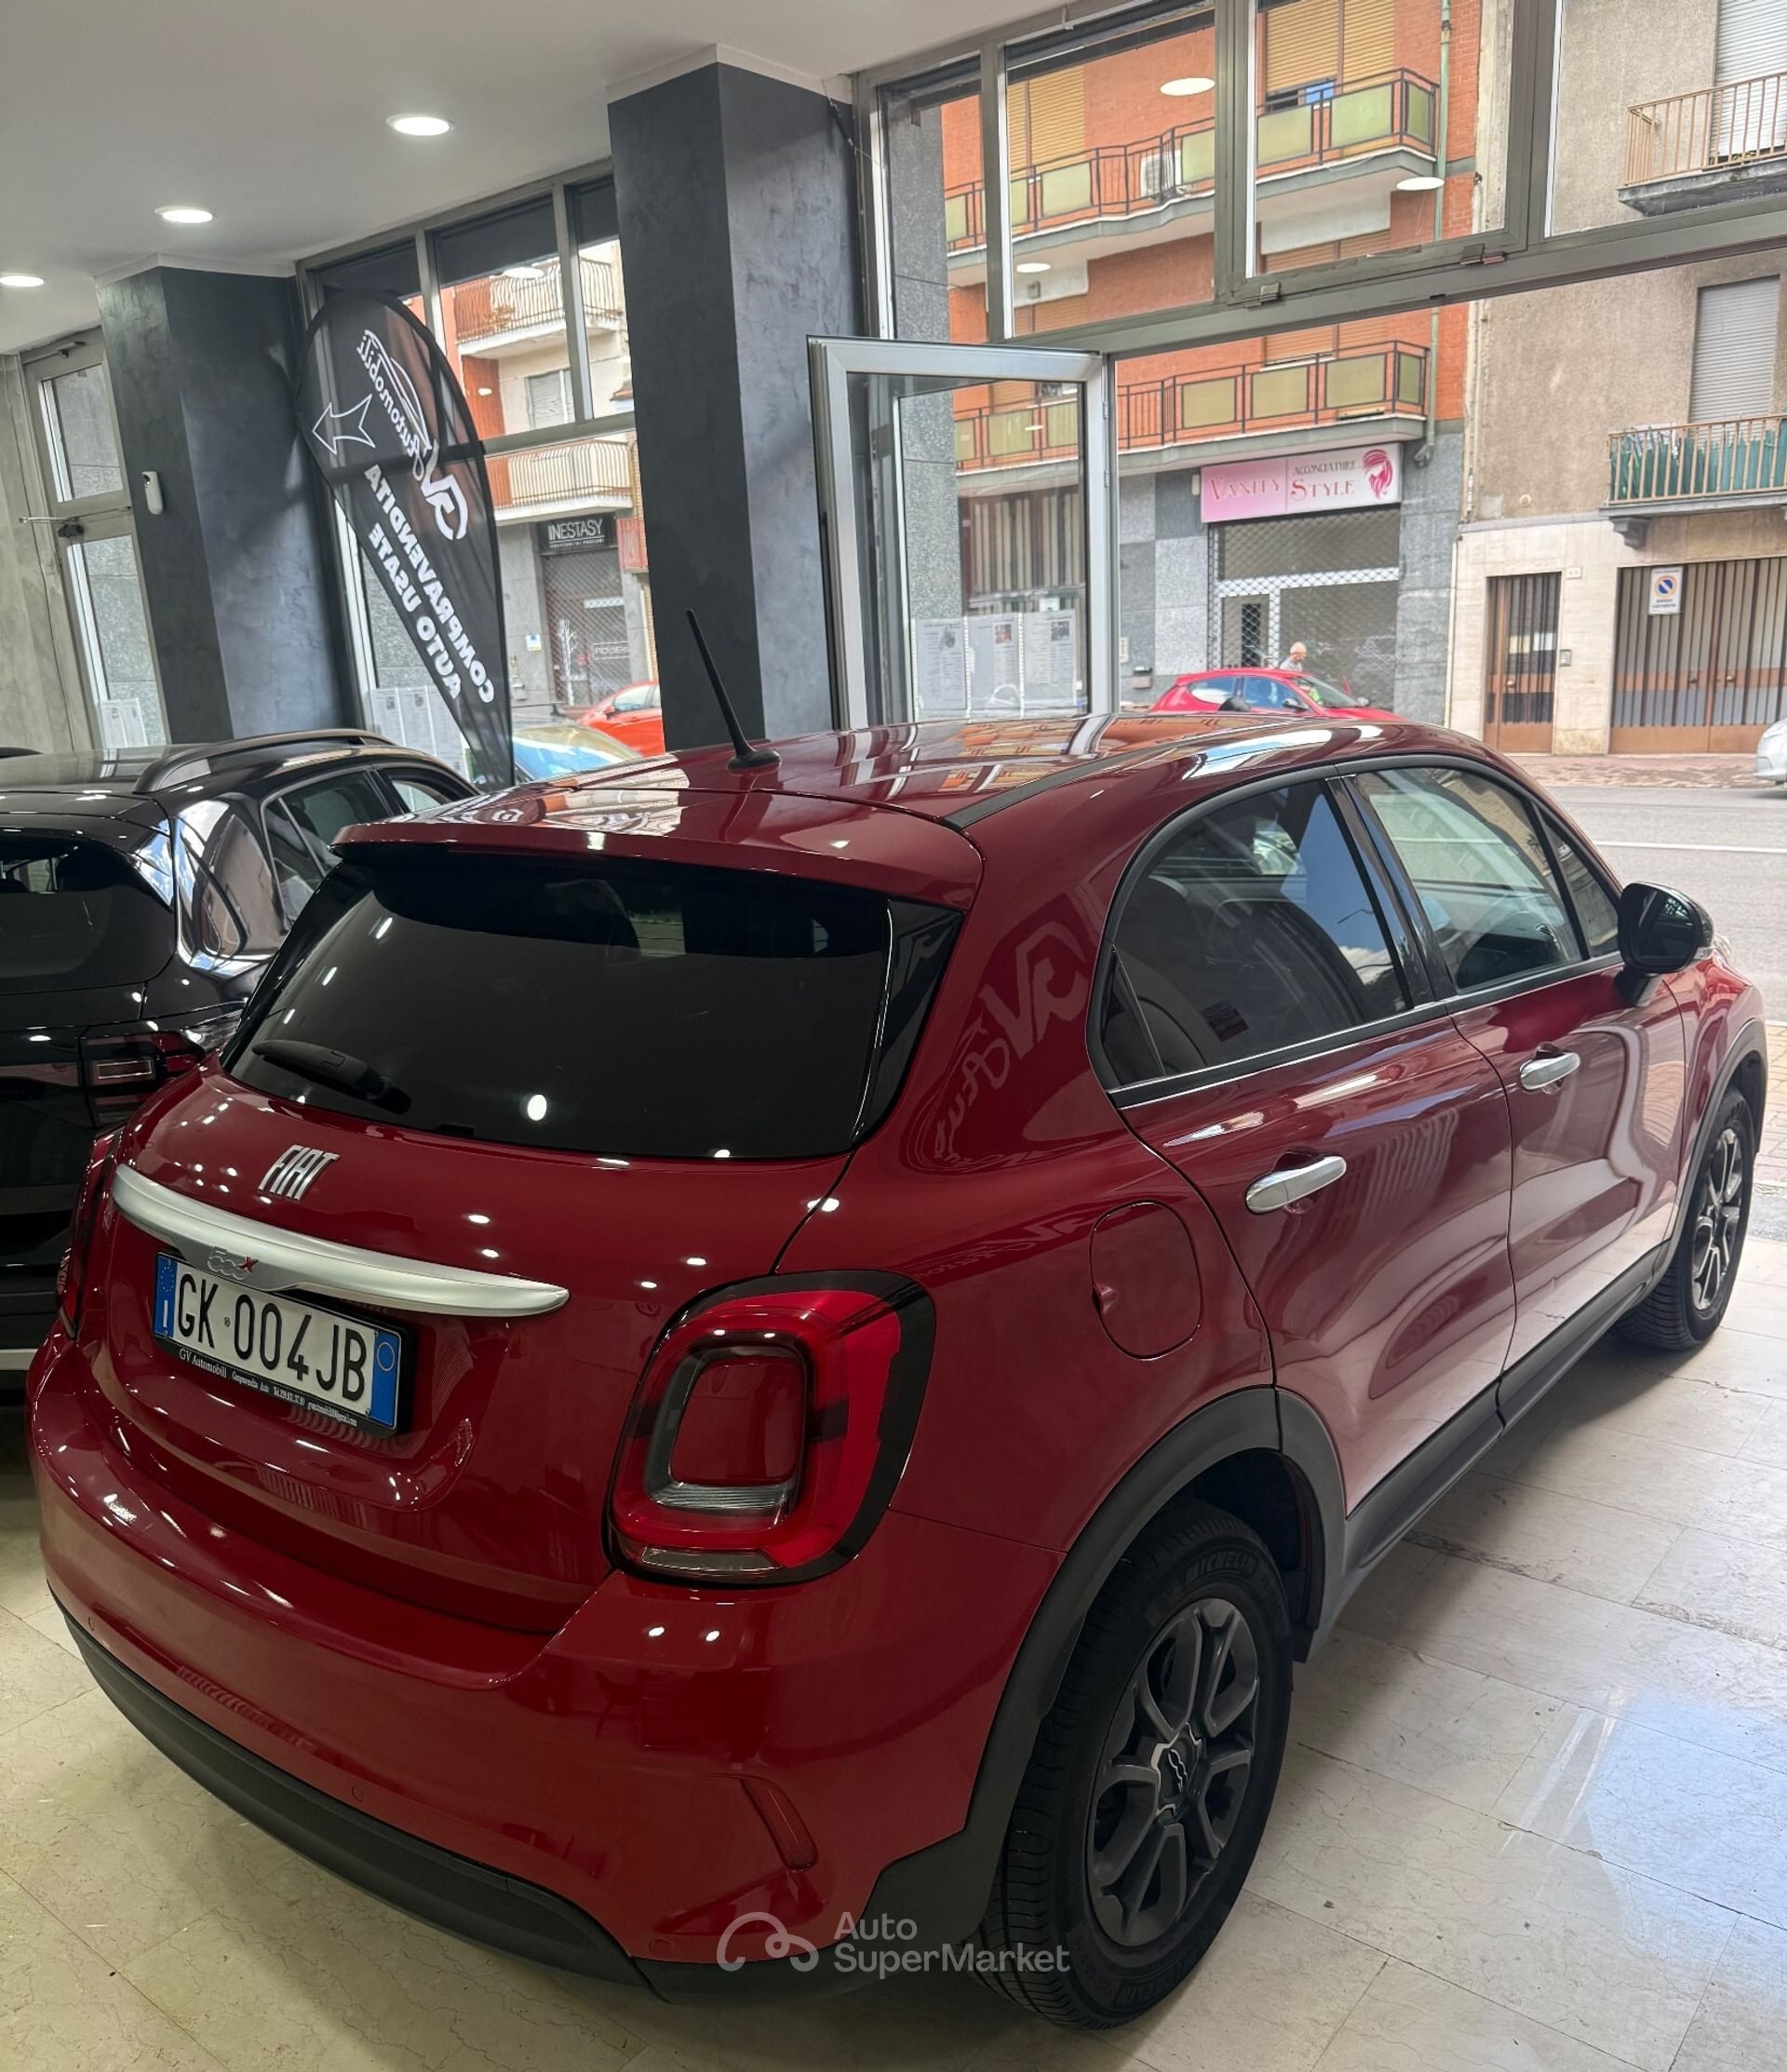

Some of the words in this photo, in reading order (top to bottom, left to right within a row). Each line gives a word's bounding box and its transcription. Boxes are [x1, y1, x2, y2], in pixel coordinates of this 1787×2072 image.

[1211, 476, 1281, 502] VANITY
[1290, 478, 1356, 503] STYLE
[547, 518, 603, 541] INESTASY
[258, 1144, 341, 1202] FIAT
[179, 1349, 192, 1361] GV
[192, 1353, 227, 1379] Automobili
